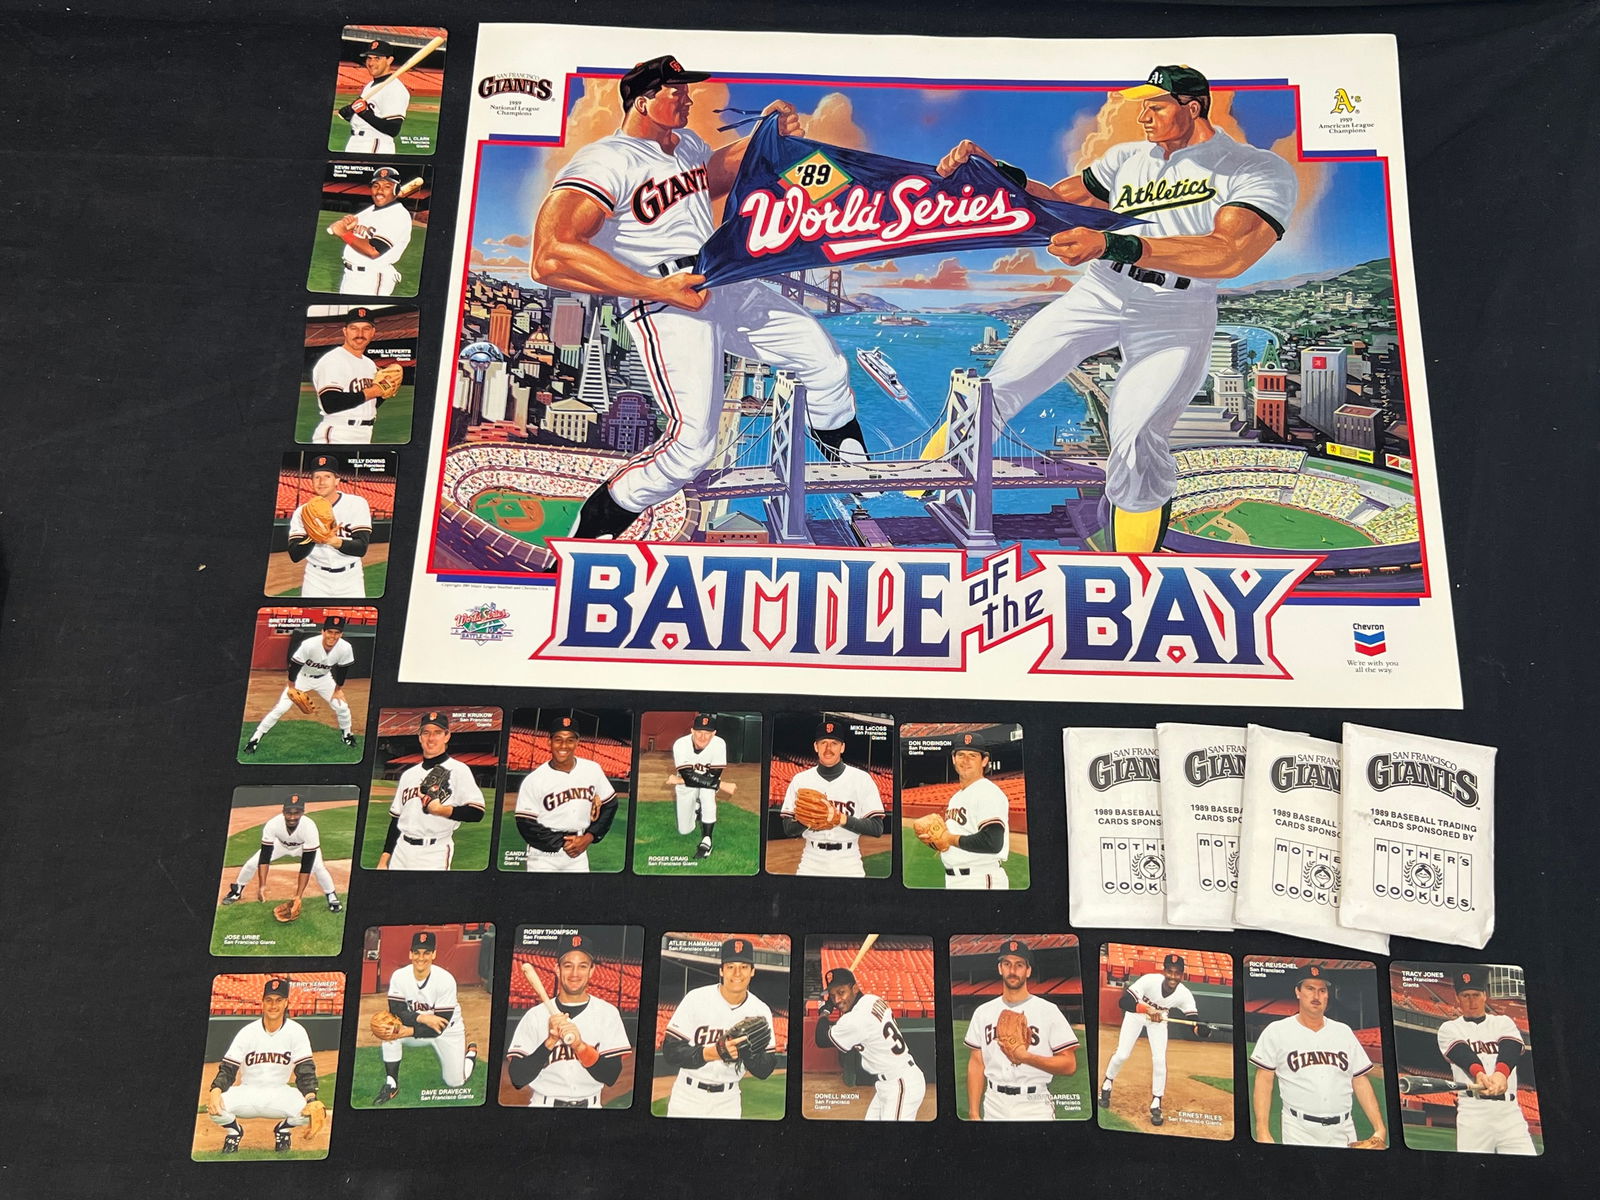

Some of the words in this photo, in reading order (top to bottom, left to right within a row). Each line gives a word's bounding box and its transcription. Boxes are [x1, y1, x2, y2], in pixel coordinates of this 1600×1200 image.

[478, 75, 552, 101] GIANTS
[796, 163, 831, 187] '89
[1113, 178, 1216, 210] Athletics
[740, 185, 884, 254] World
[880, 177, 1030, 242] Series
[562, 552, 951, 658] BATTLE
[982, 588, 1045, 641] the
[1058, 564, 1296, 666] BAY
[1352, 622, 1384, 630] Chevron
[1113, 748, 1130, 758] SAN
[1208, 745, 1225, 754] SAN
[1297, 754, 1314, 762] SAN
[1392, 752, 1410, 760] SAN
[1410, 752, 1458, 771] FRANCISCO
[1366, 753, 1479, 808] GIANTS
[1094, 808, 1113, 816] 1989
[1190, 804, 1209, 812] 1989
[1194, 814, 1225, 822] CARDS
[1272, 808, 1291, 818] 1989
[1292, 812, 1337, 828] BASEBALL
[1275, 818, 1305, 832] CARDS
[1370, 808, 1389, 817] 1989
[1390, 811, 1436, 825] BASEBALL
[1437, 819, 1477, 832] TRADING
[1373, 818, 1404, 830] CARDS
[1406, 822, 1460, 839] SPONSORED
[1462, 833, 1474, 841] BY
[883, 1021, 906, 1056] 3
[245, 1051, 291, 1066] GIANTS
[1287, 1050, 1349, 1073] GIANTS
